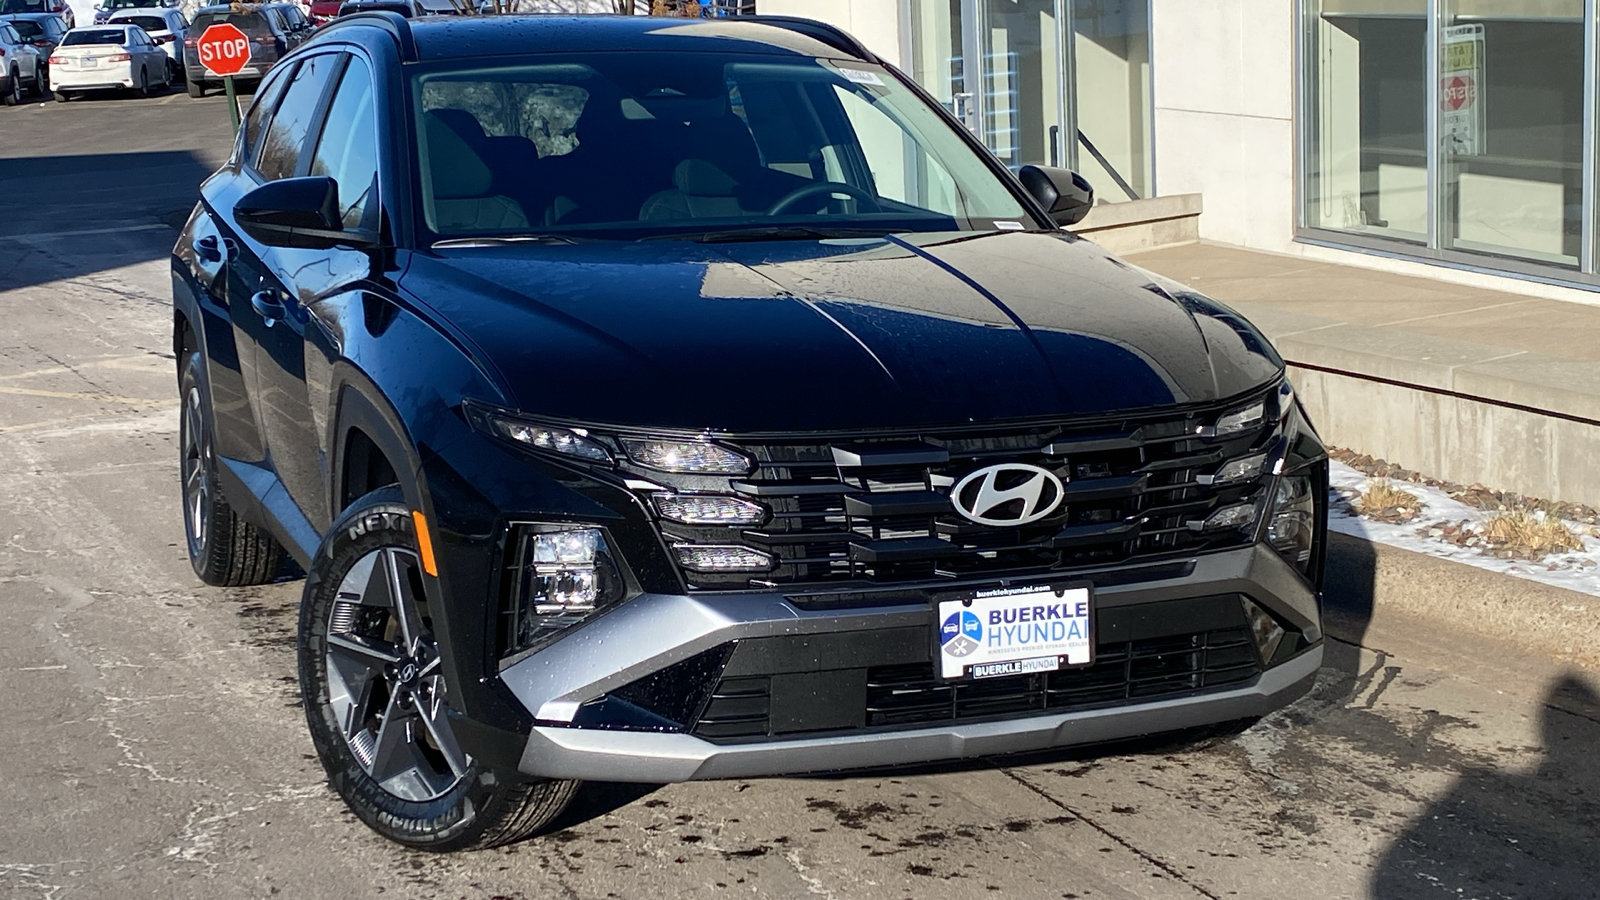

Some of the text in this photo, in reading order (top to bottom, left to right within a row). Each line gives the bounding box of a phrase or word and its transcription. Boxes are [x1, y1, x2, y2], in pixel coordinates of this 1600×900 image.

[202, 38, 246, 62] STOP
[977, 585, 1051, 598] buerklehyundai.com
[989, 602, 1088, 626] BUERKLE
[988, 619, 1088, 648] HYUNDAI
[974, 658, 1057, 677] BUERKLE HYUNDAI
